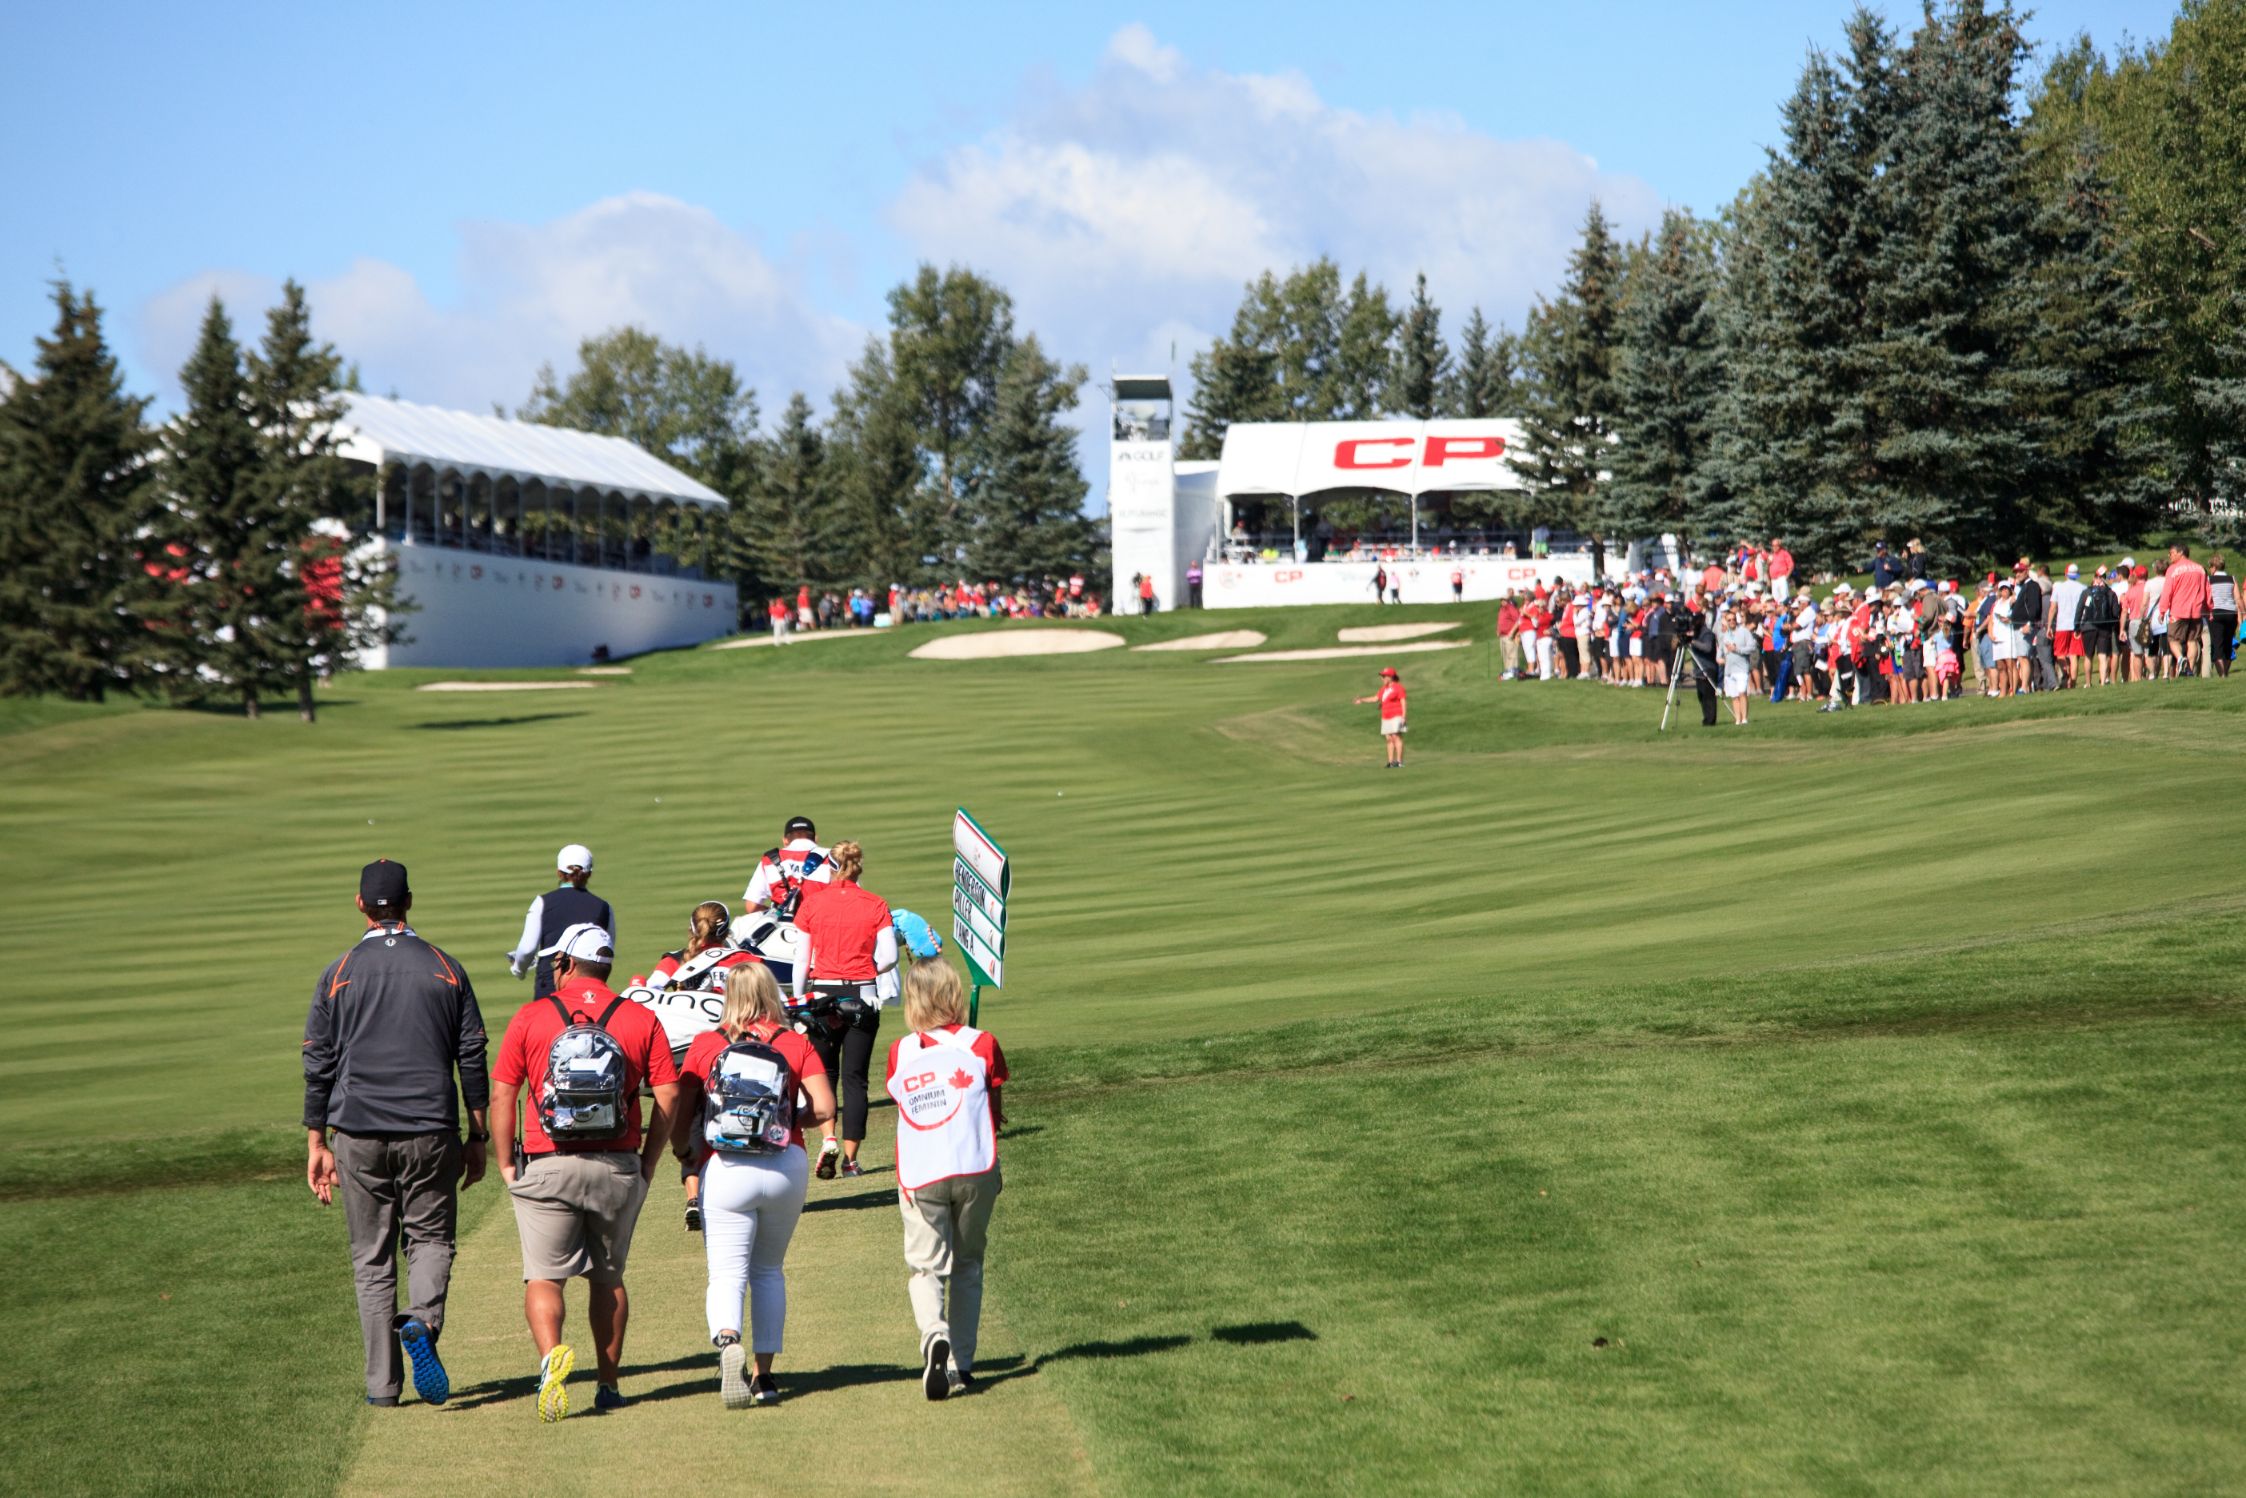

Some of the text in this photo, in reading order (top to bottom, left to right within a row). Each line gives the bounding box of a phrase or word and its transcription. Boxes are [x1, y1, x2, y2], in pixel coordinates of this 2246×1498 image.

[1133, 450, 1164, 461] GOLF
[1334, 436, 1506, 469] CP
[1274, 570, 1303, 584] CP
[1508, 567, 1536, 581] CP
[955, 860, 986, 909] HENDERSON
[954, 888, 973, 924] PILLER
[956, 918, 969, 949] YANG
[903, 1071, 936, 1093] CP
[908, 1089, 945, 1106] OMNIUM
